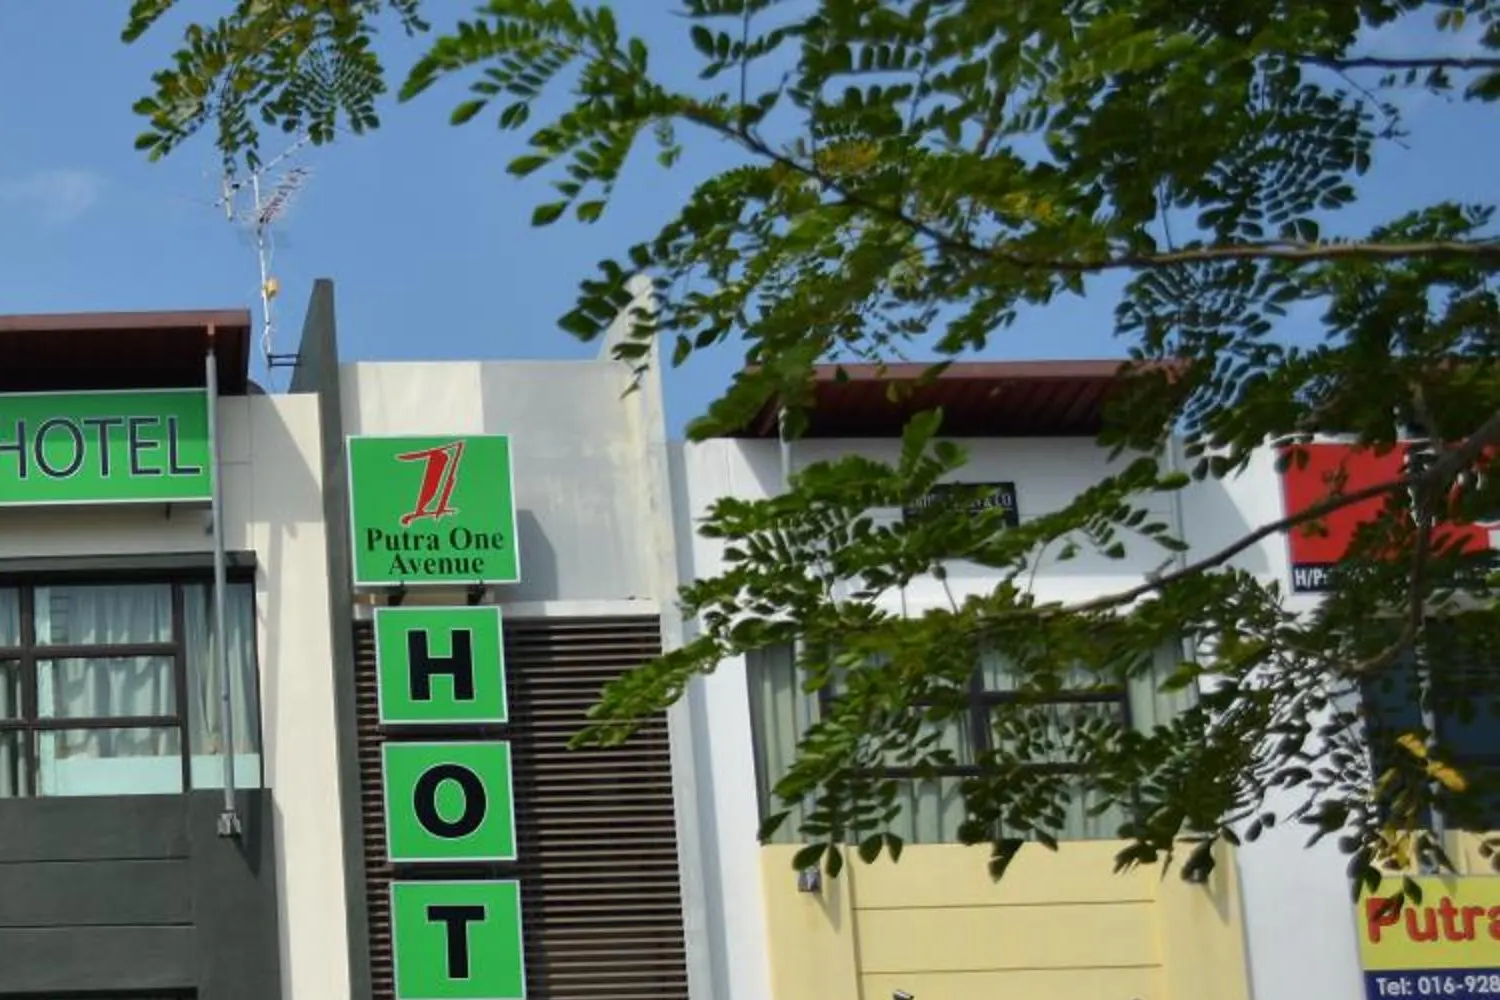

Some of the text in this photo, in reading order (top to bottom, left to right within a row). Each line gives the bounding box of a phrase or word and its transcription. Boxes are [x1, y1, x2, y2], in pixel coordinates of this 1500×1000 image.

[366, 526, 504, 551] Putra One
[388, 553, 485, 575] Avenue
[1376, 977, 1413, 996] Tel:
